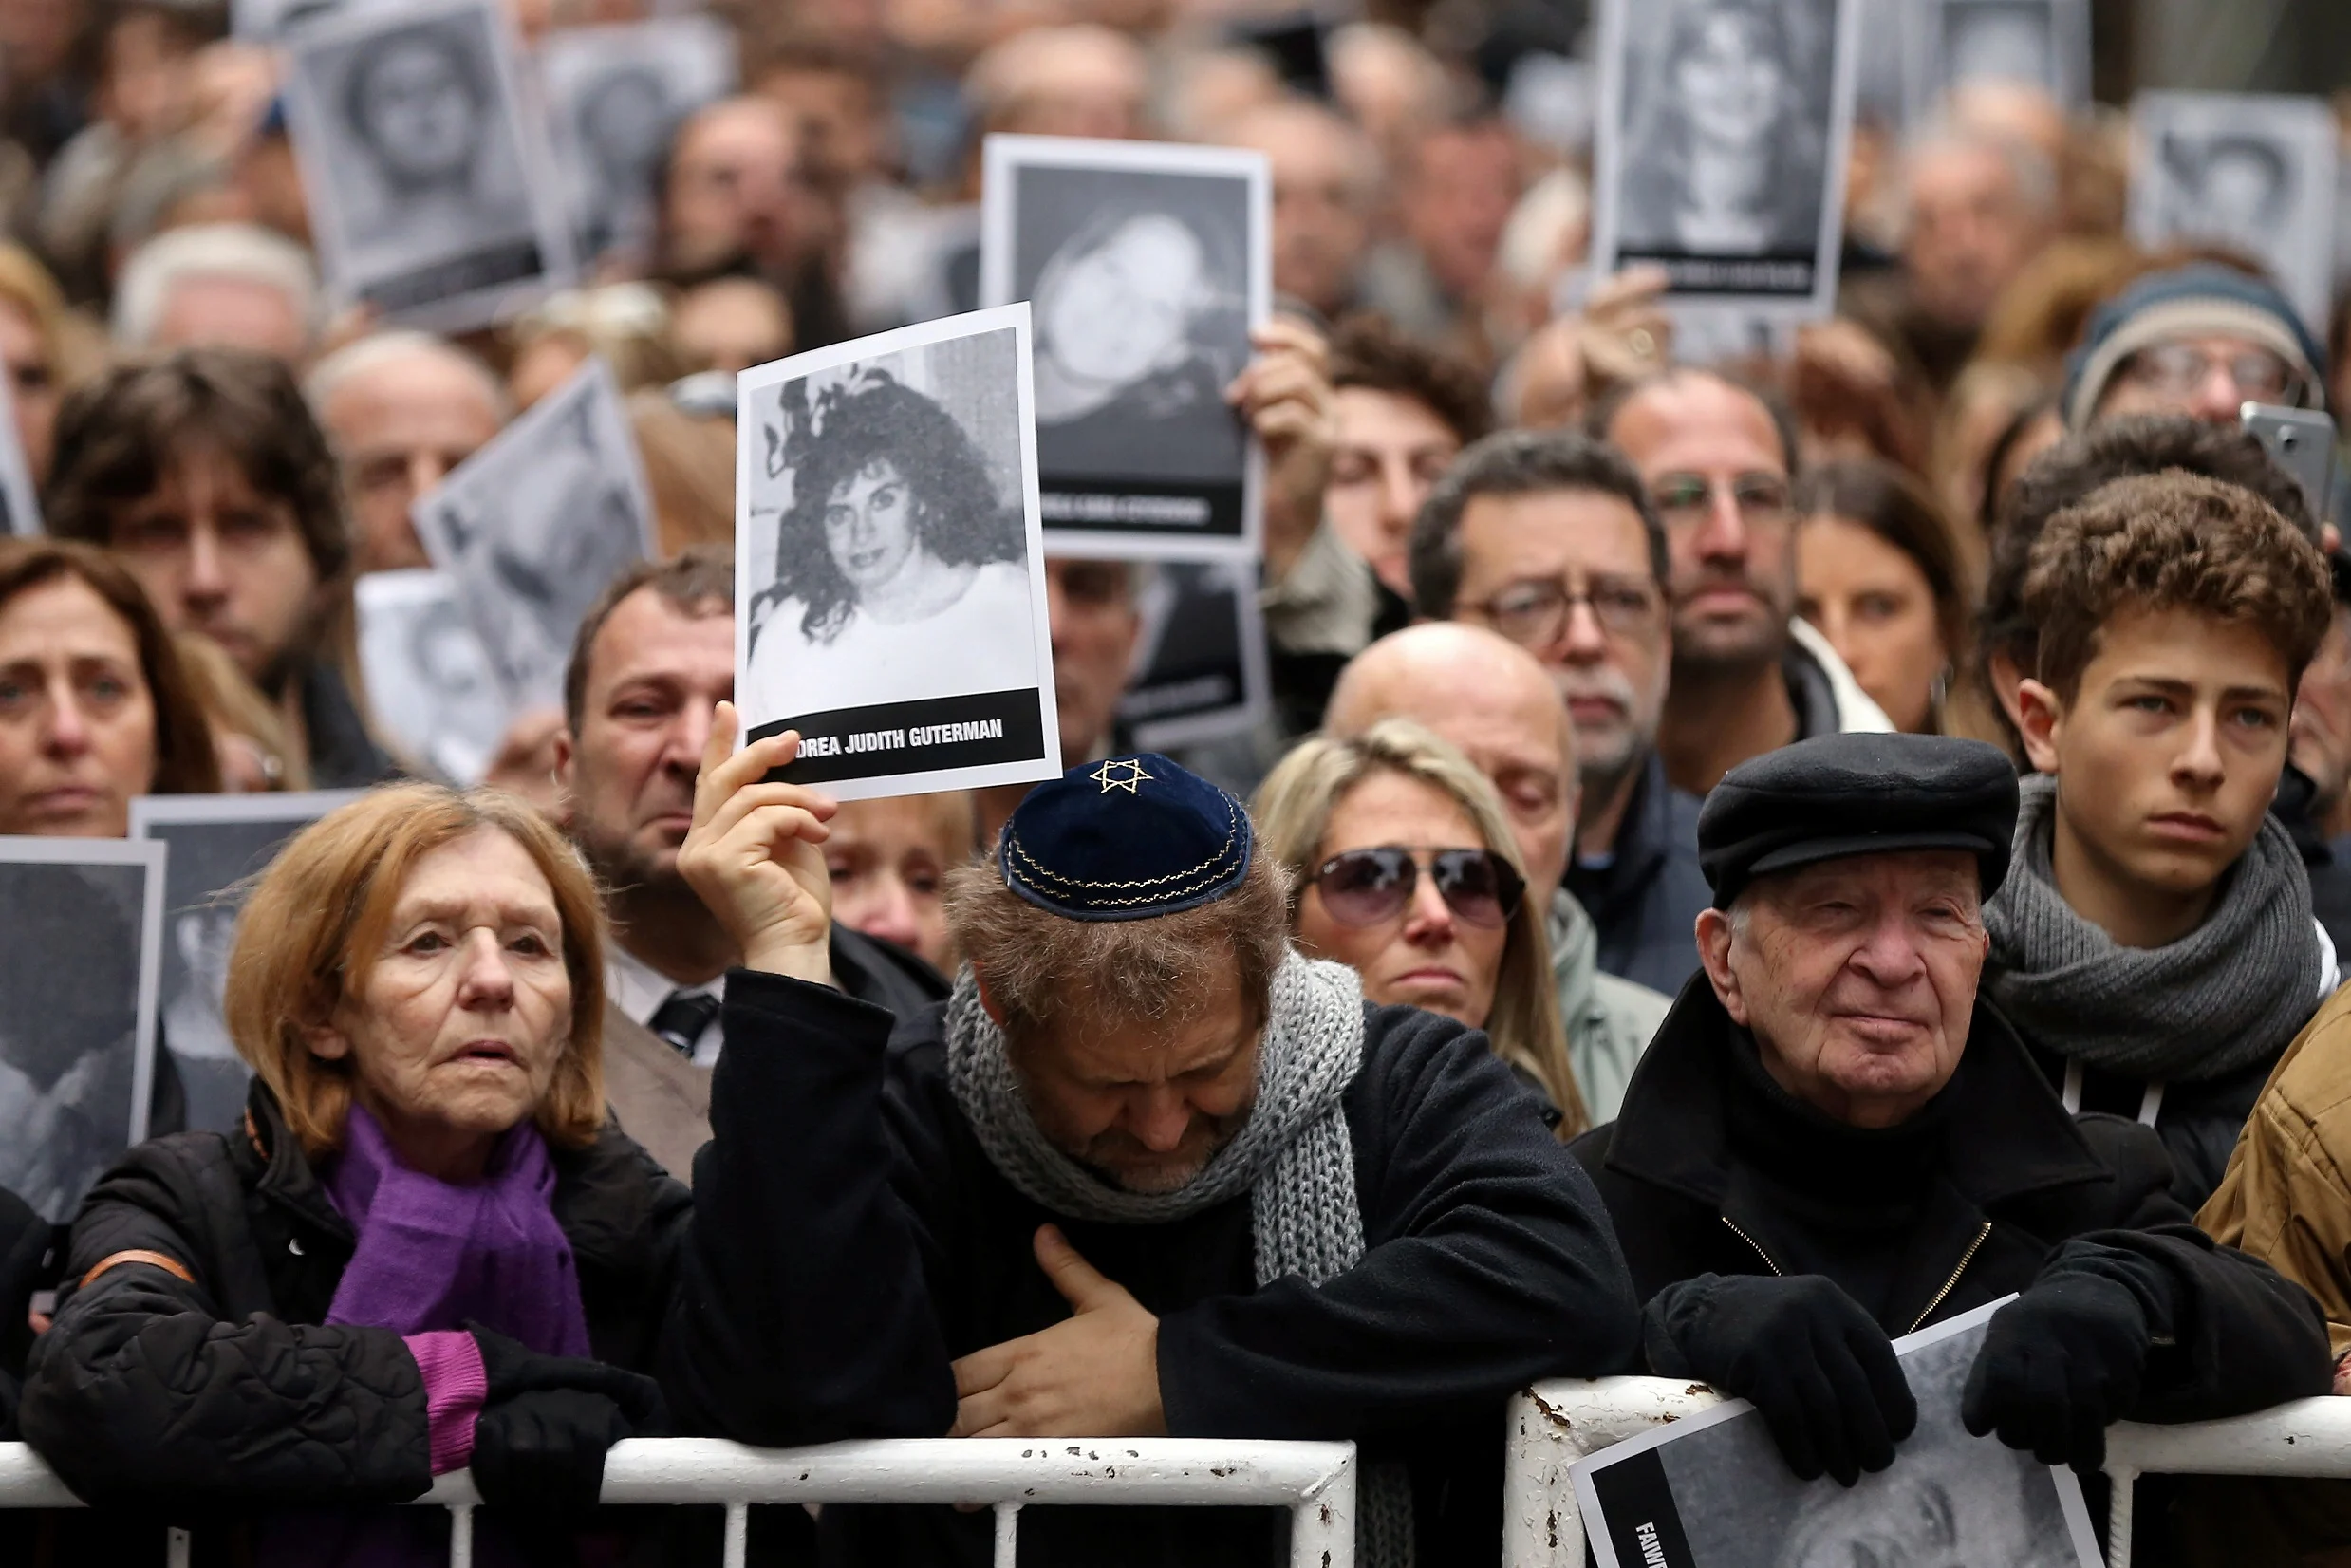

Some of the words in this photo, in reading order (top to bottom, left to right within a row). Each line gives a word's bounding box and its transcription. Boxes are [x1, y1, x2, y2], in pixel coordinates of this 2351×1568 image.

[795, 736, 843, 759] DREA
[844, 728, 905, 754] JUDITH
[909, 719, 1003, 747] GUTERMAN
